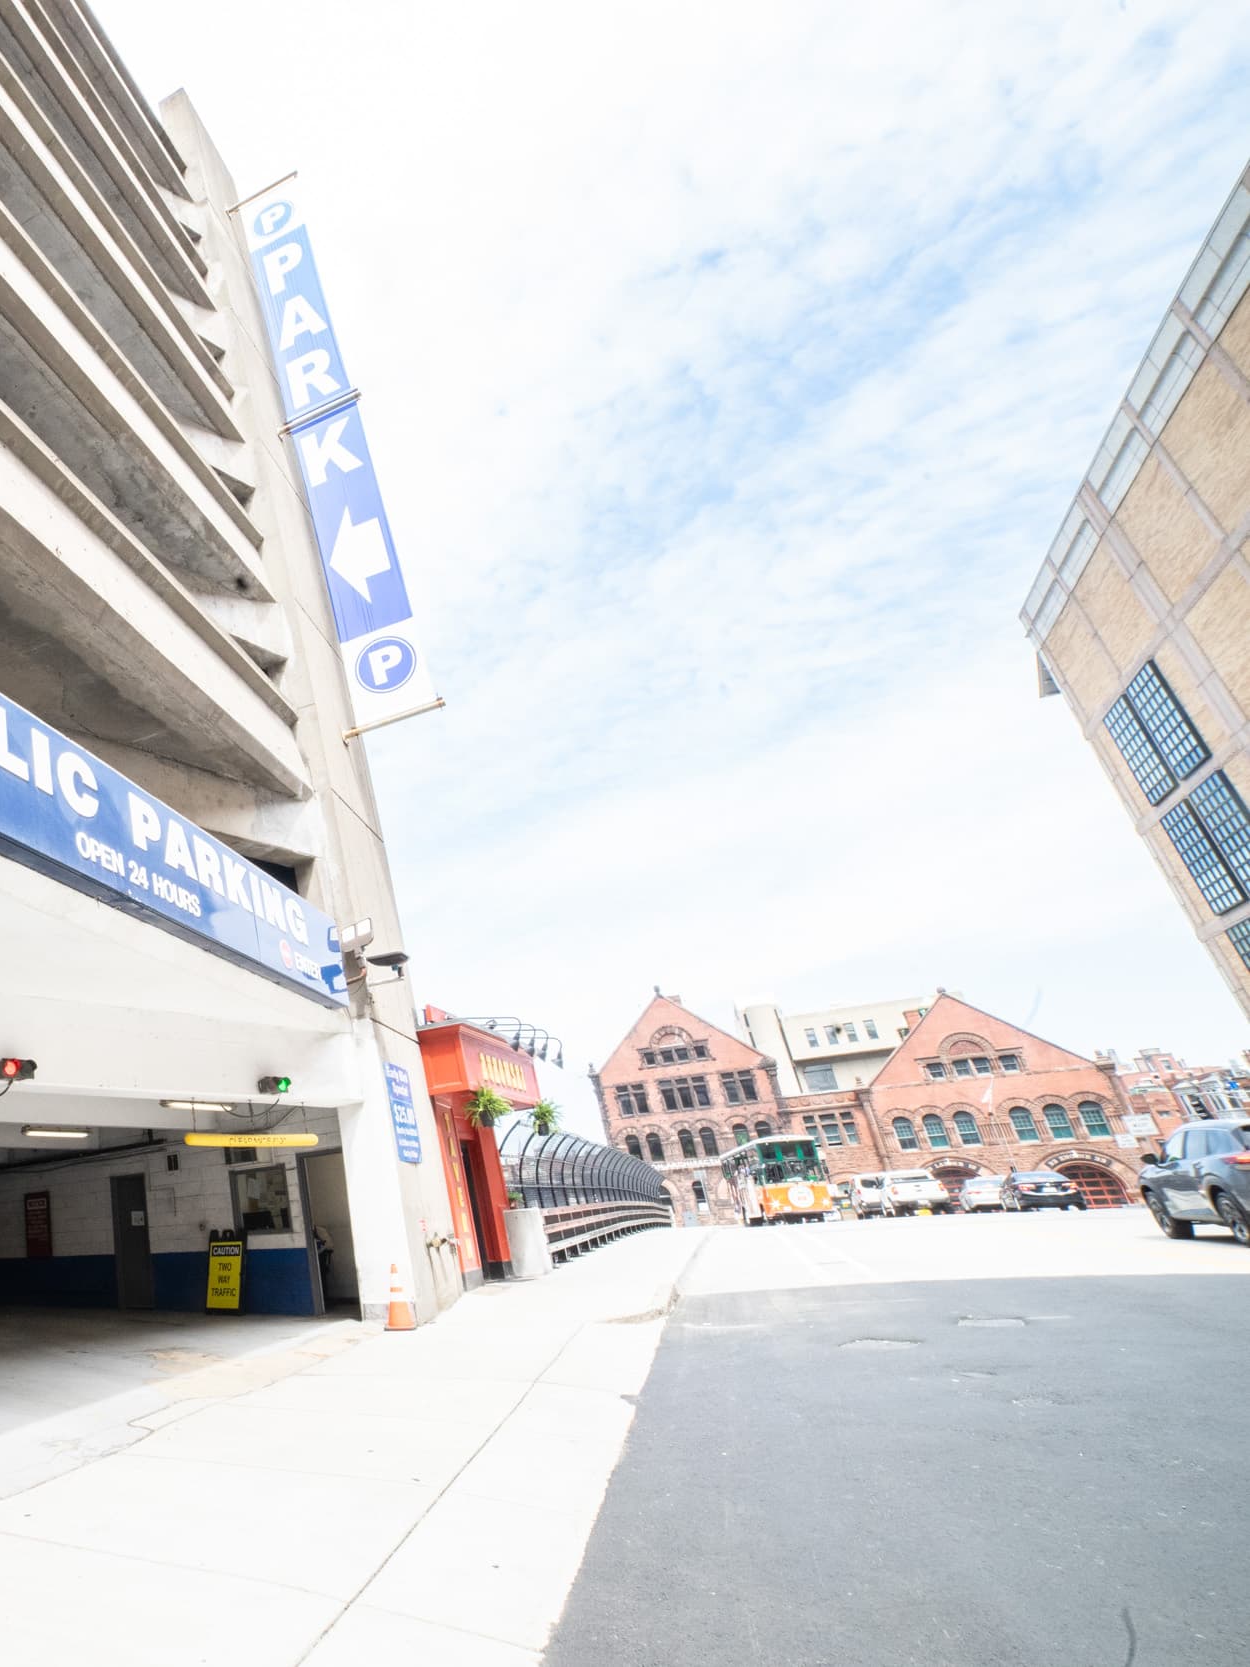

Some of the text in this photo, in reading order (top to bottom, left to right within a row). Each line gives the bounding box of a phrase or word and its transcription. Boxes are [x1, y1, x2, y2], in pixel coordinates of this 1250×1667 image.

[262, 241, 364, 488] PARK
[75, 831, 202, 917] OPEN 24 HOURS
[128, 791, 309, 947] PARKING
[444, 1112, 474, 1261] TAVERN
[213, 1246, 240, 1256] CAUTION
[218, 1263, 232, 1272] TWO
[211, 1287, 237, 1297] TRAFFIC
[218, 1275, 231, 1285] WAY
